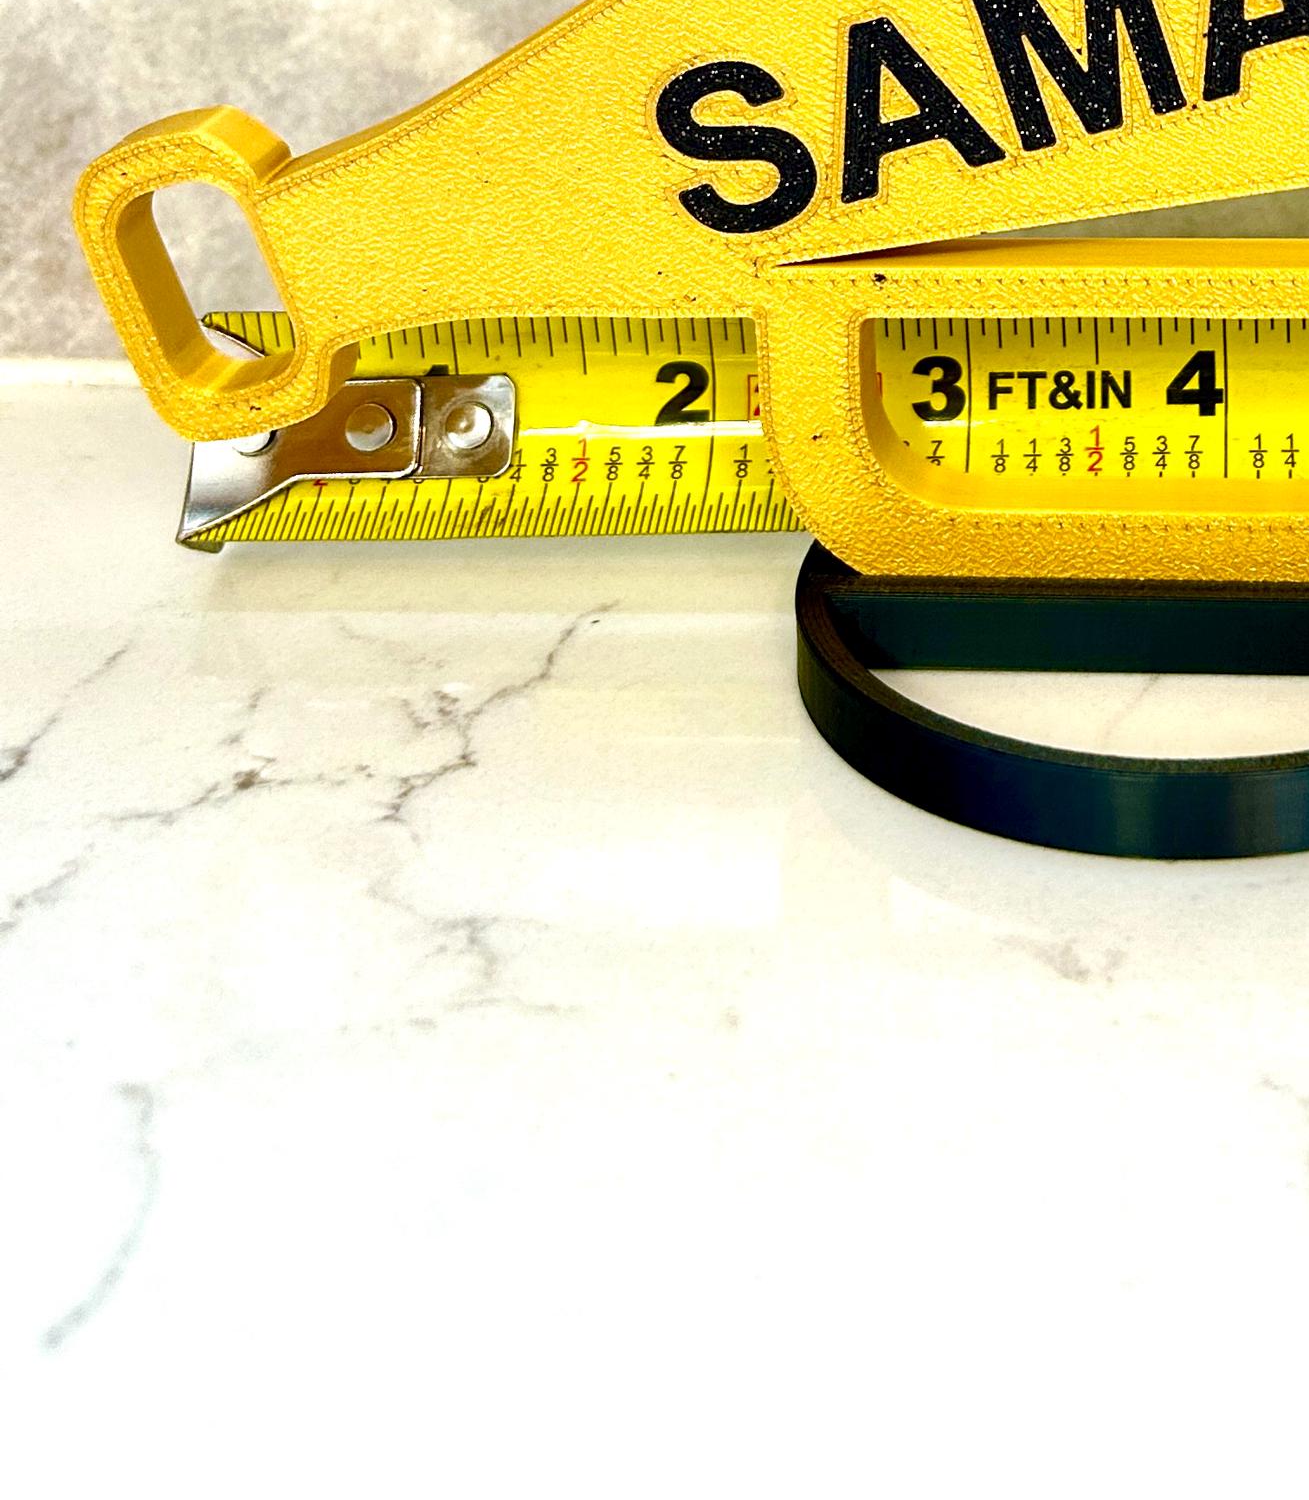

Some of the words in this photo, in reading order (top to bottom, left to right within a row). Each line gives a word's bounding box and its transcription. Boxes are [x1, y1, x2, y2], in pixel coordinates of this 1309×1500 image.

[655, 360, 711, 427] 2
[911, 355, 966, 422] 3
[988, 369, 1132, 411] FT&IN
[1166, 349, 1224, 417] 4
